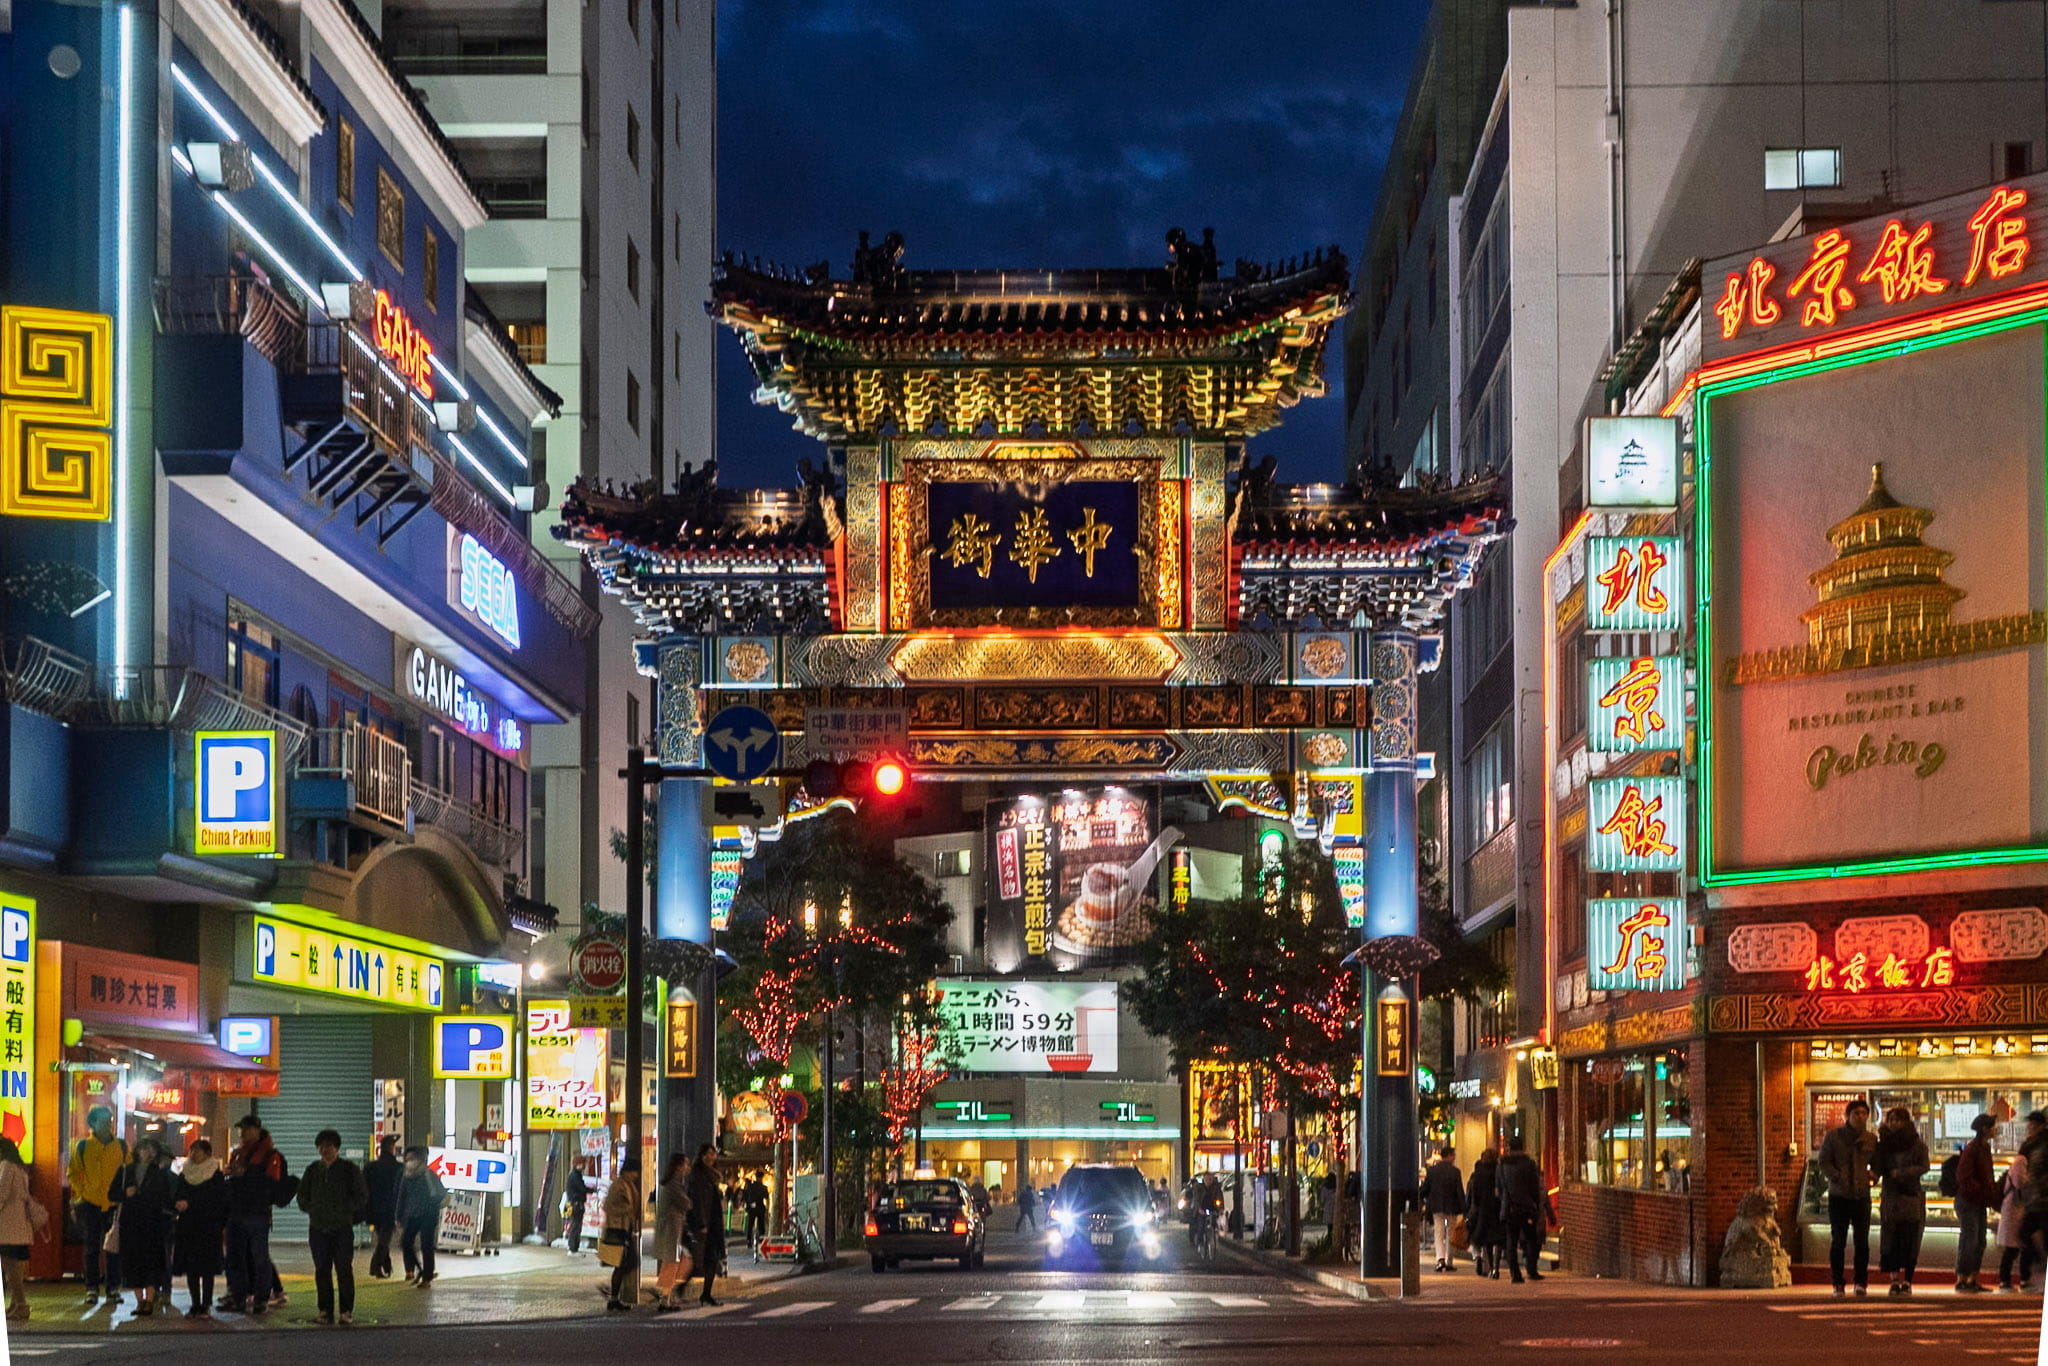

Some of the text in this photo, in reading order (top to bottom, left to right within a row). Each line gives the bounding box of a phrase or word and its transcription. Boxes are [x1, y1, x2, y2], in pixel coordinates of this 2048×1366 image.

[1716, 186, 2029, 340] 北京飯店
[374, 289, 435, 399] GAME
[461, 533, 521, 650] SEGA
[411, 648, 465, 722] GAME
[1845, 684, 1918, 705] CHINESE
[812, 713, 901, 732] 中華街東門
[1788, 704, 1904, 732] RESTAURANT
[1927, 697, 1965, 714] BAR
[820, 734, 849, 745] China
[853, 734, 880, 745] Town
[1597, 542, 1677, 984] 北京飯店
[1805, 733, 1947, 791] Peking
[208, 747, 265, 818] P
[201, 829, 271, 847] China Parking
[1001, 833, 1016, 895] 横浜名物
[1024, 823, 1046, 956] 正宗生煎包
[3, 910, 29, 958] P
[257, 926, 274, 974] P
[291, 944, 318, 976] 一般
[350, 948, 369, 991] IN
[430, 966, 441, 1005] P
[583, 955, 621, 976] 消火栓
[1805, 947, 1954, 994] 北京飯店
[5, 966, 24, 1064] 一般有料
[949, 988, 1030, 1008] ここから、
[228, 1022, 264, 1054] P
[442, 1023, 504, 1071] P
[2, 1070, 27, 1098] IN
[476, 1160, 506, 1184] P
